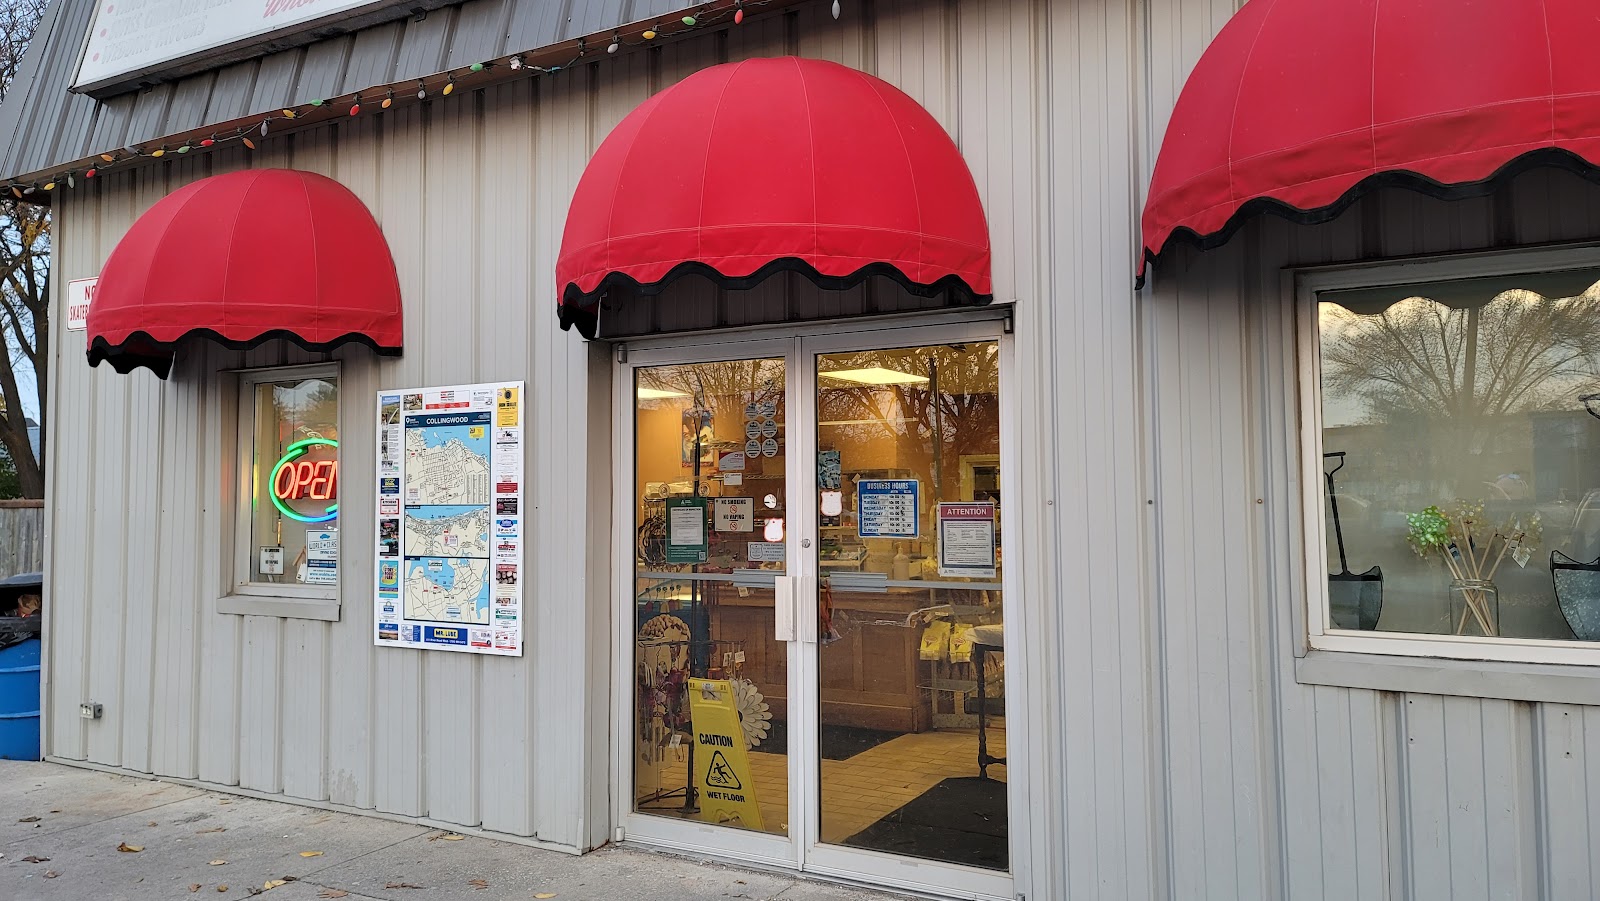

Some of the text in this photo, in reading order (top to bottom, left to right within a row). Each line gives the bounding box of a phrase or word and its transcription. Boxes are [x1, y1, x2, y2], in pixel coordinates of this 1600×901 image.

[426, 416, 469, 425] COLLINGWOOD
[891, 481, 909, 490] HOURS
[947, 508, 987, 516] ATTENTION
[445, 630, 457, 638] LUBE
[699, 733, 733, 747] CAUTION
[707, 791, 745, 802] WET FLOOR
